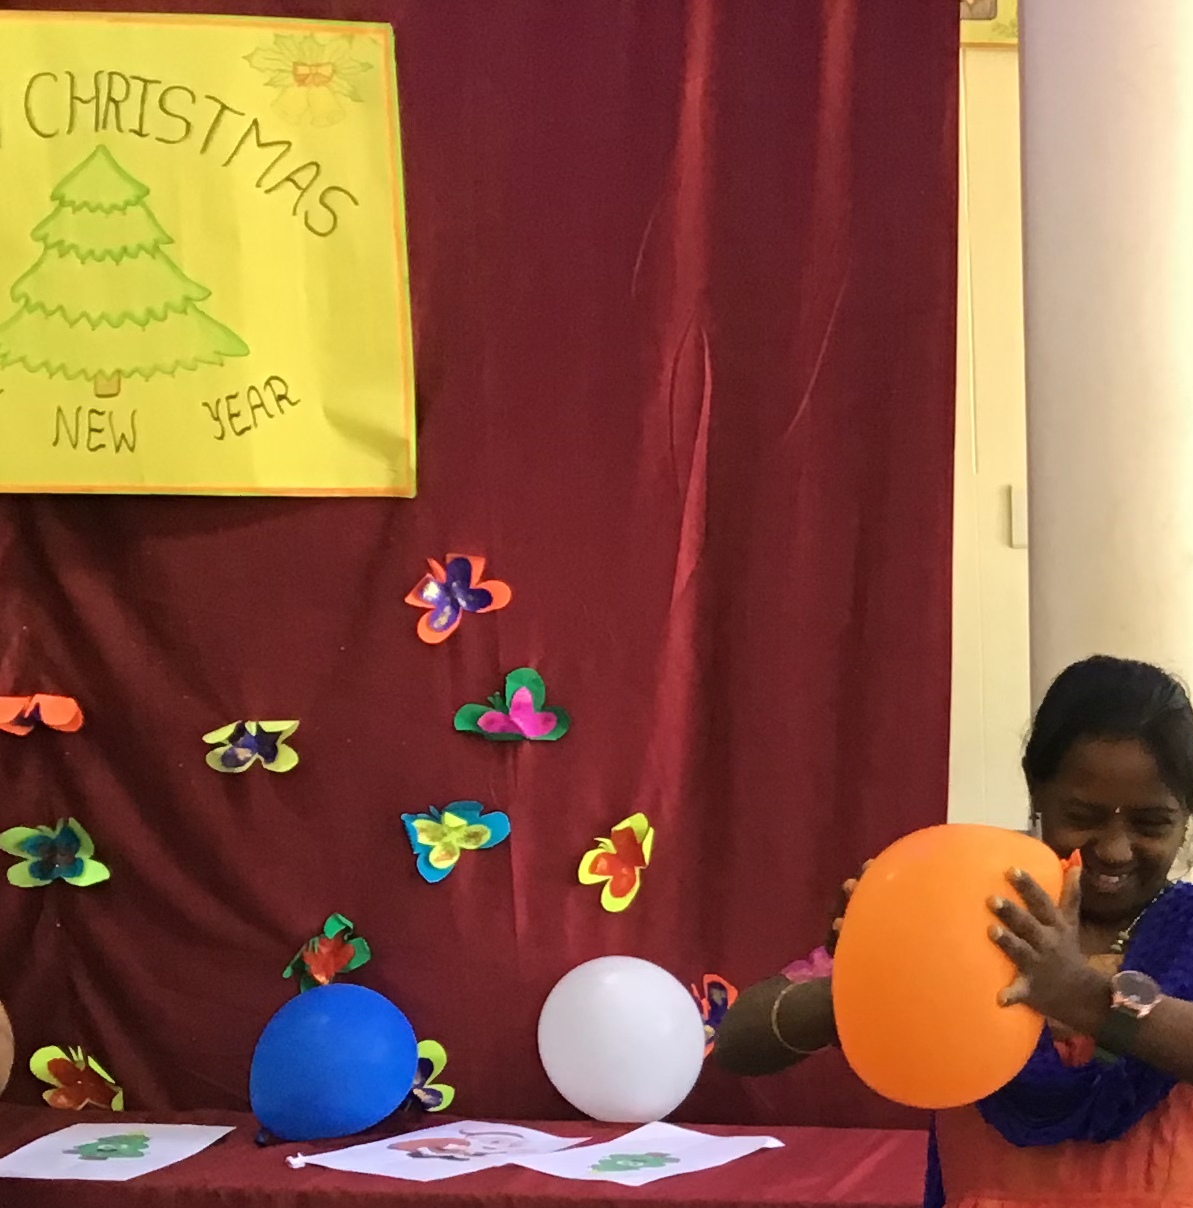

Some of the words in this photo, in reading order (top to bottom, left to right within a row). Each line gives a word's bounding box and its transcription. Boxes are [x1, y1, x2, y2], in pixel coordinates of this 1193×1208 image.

[24, 70, 359, 237] CHRISTMAS
[52, 405, 137, 454] NEW
[202, 375, 300, 440] YEAR
